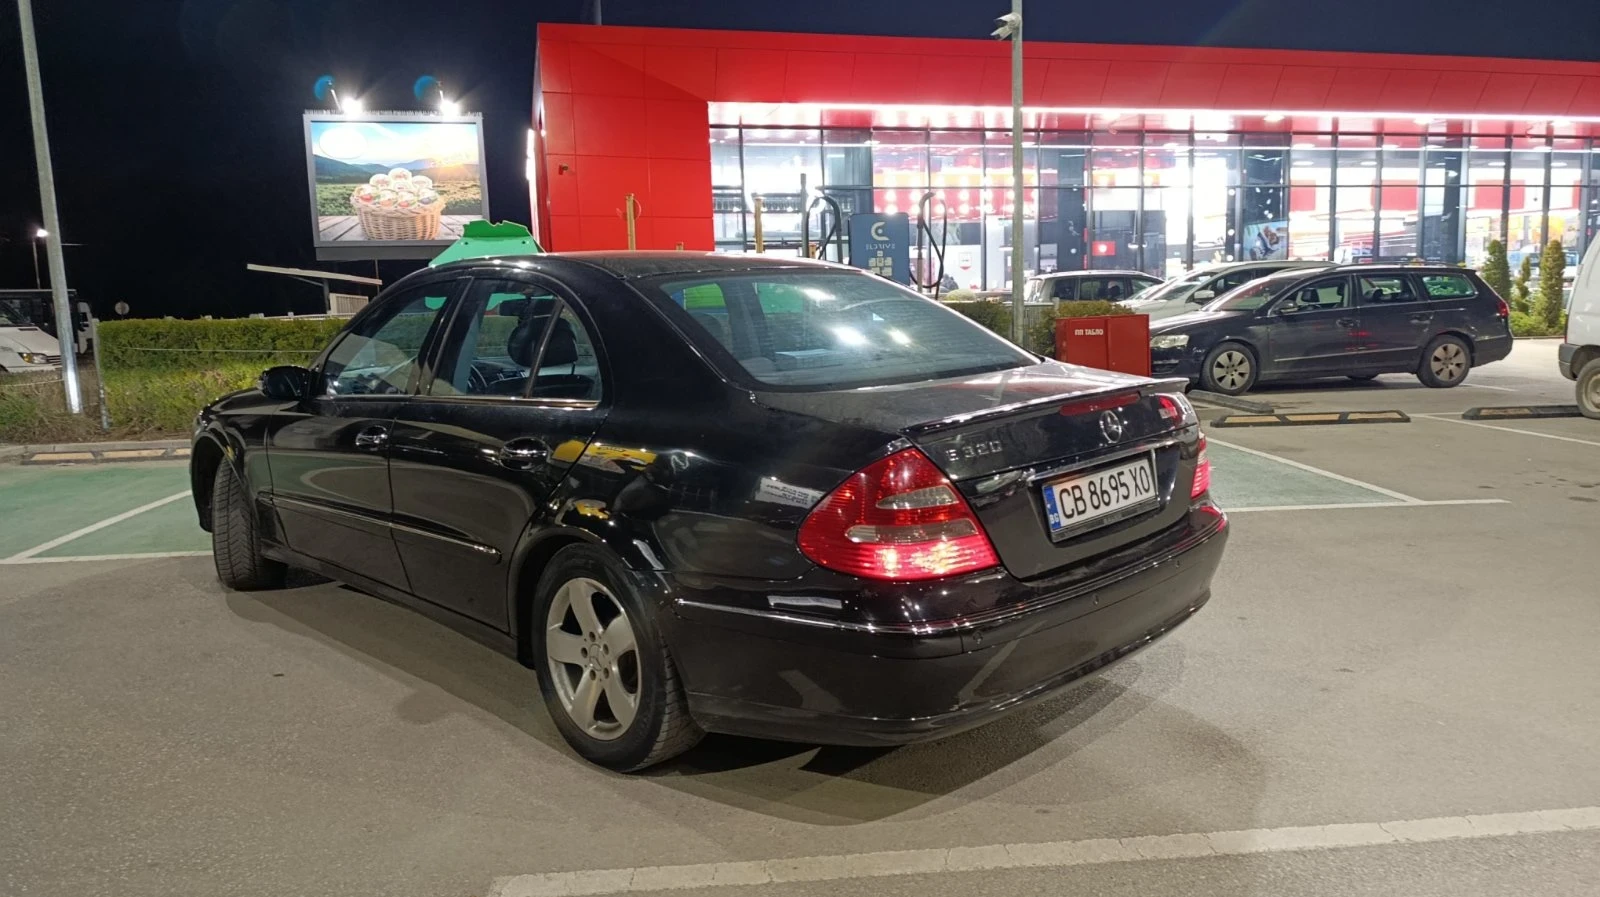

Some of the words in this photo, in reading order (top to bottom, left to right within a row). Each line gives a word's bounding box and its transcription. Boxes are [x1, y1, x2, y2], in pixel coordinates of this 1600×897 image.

[1085, 328, 1104, 336] ТАБЛО
[962, 441, 1002, 458] 320
[1059, 484, 1087, 519] CB
[1088, 470, 1130, 510] 8695
[1129, 465, 1151, 497] XO
[1049, 512, 1060, 524] BG
